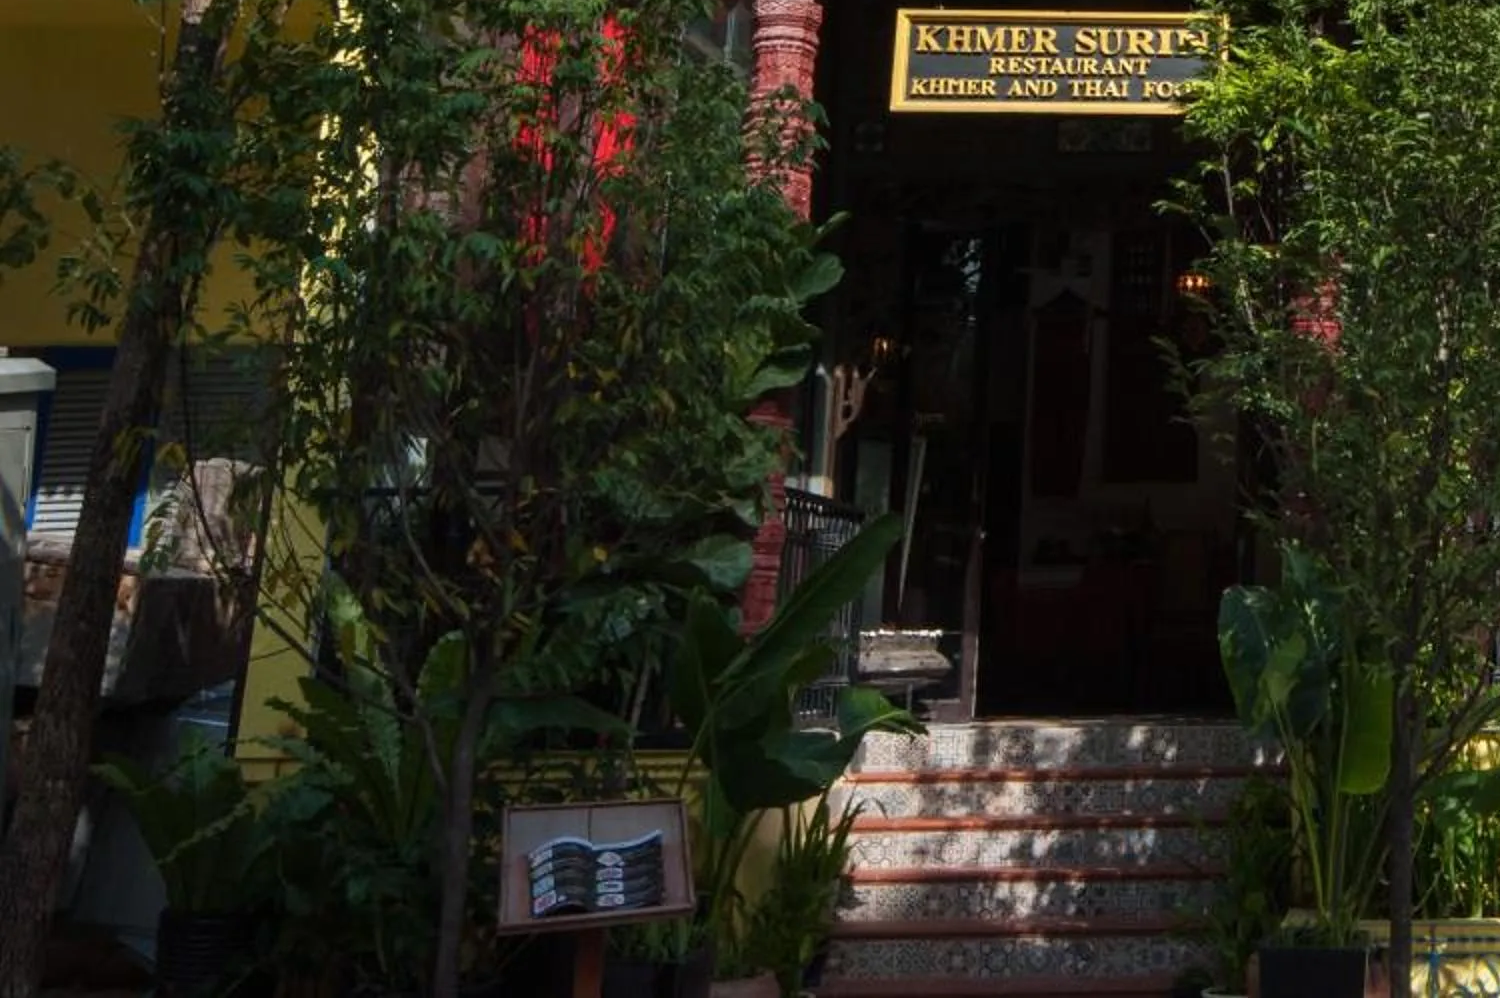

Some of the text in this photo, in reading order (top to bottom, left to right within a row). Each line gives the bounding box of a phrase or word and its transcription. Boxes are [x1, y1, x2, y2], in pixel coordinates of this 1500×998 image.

[914, 25, 1060, 53] KHMER
[989, 57, 1152, 77] RESTAURANT
[910, 78, 996, 97] KHMER
[1007, 79, 1058, 98] AND
[1068, 79, 1130, 98] THAI
